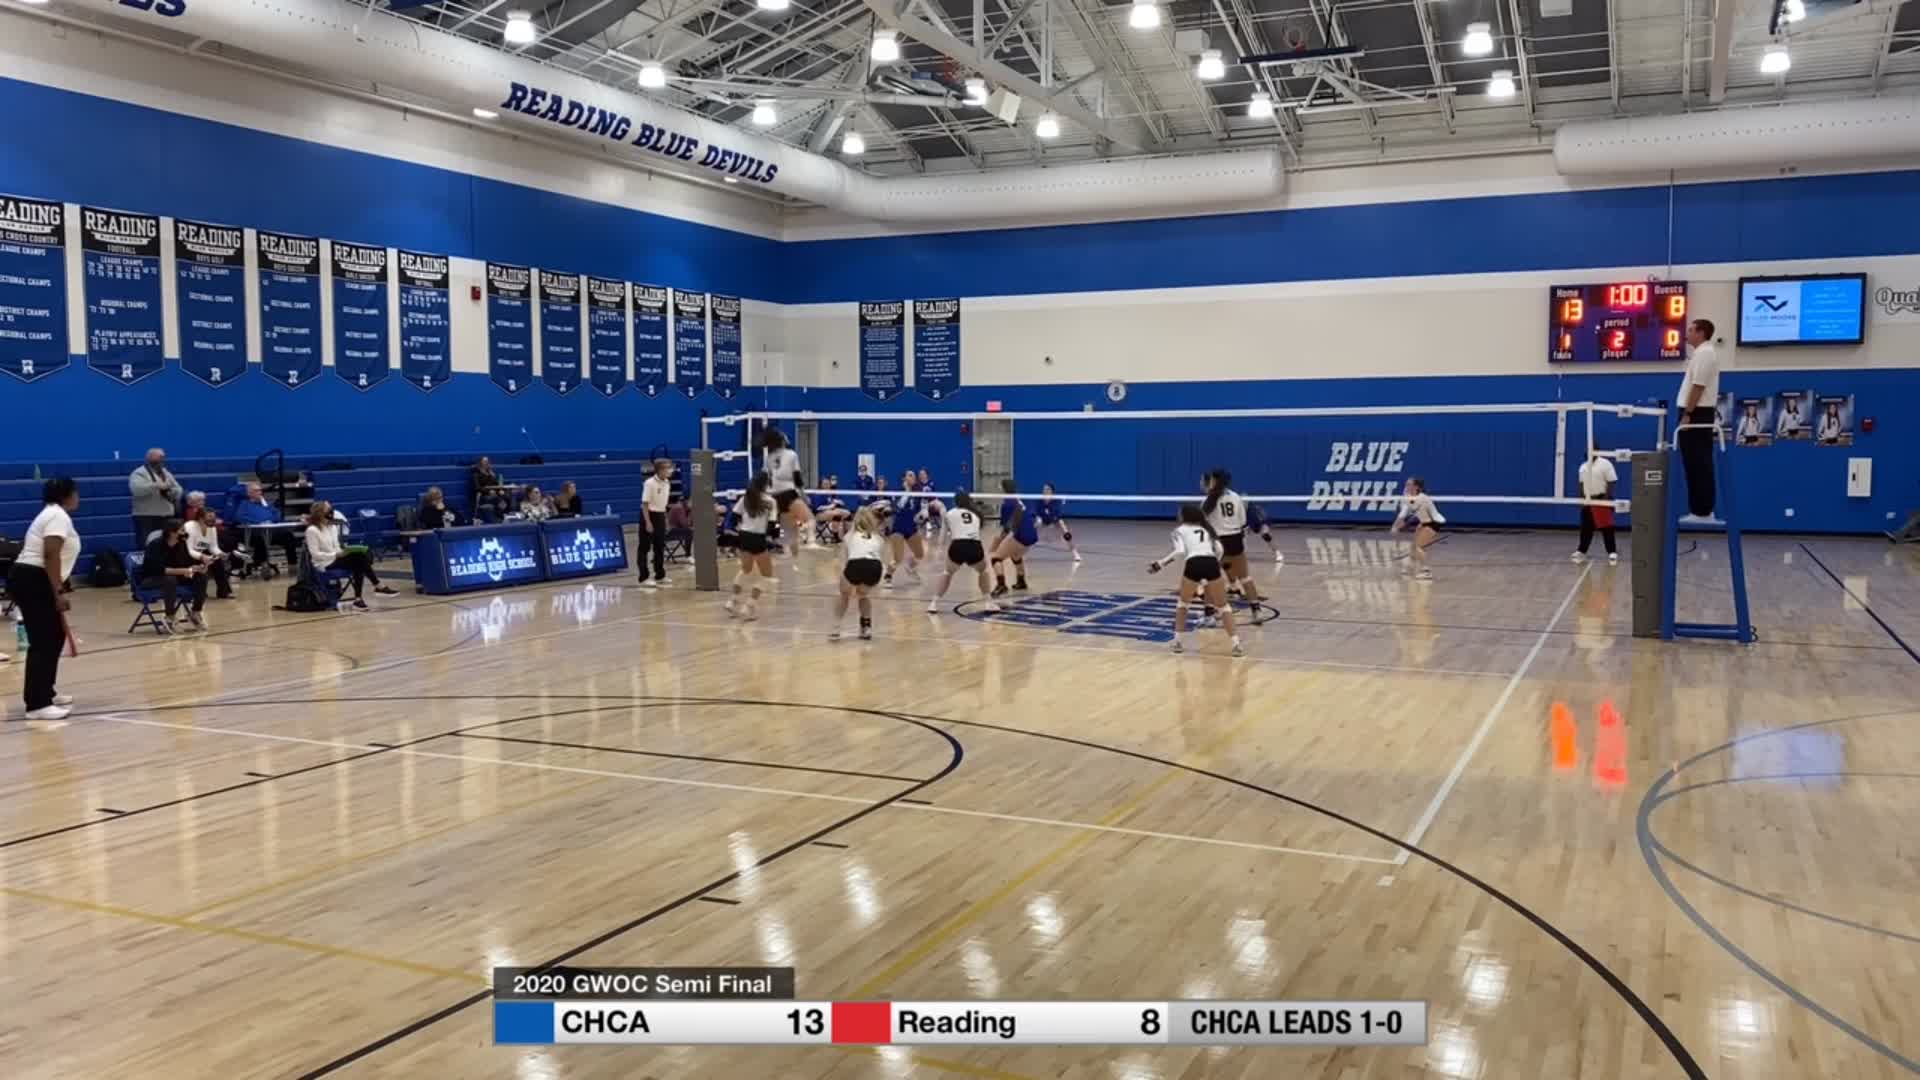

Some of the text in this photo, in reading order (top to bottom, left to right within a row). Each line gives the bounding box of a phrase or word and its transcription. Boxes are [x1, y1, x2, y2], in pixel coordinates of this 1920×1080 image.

[501, 82, 778, 183] READING BLUE DEVILS
[85, 210, 158, 237] READING
[178, 223, 241, 248] READING
[261, 234, 318, 257] READING
[334, 244, 386, 266] READING
[400, 252, 448, 274] READING
[1609, 284, 1648, 306] 1:00
[1564, 298, 1583, 321] 13
[1670, 295, 1685, 318] 8
[1613, 330, 1626, 348] 2
[1667, 329, 1680, 347] 0
[1325, 441, 1409, 472] BLUE
[961, 511, 973, 525] 9
[1220, 501, 1235, 518] 18
[1193, 529, 1205, 544] 7
[551, 546, 621, 565] BLUE DEVILS
